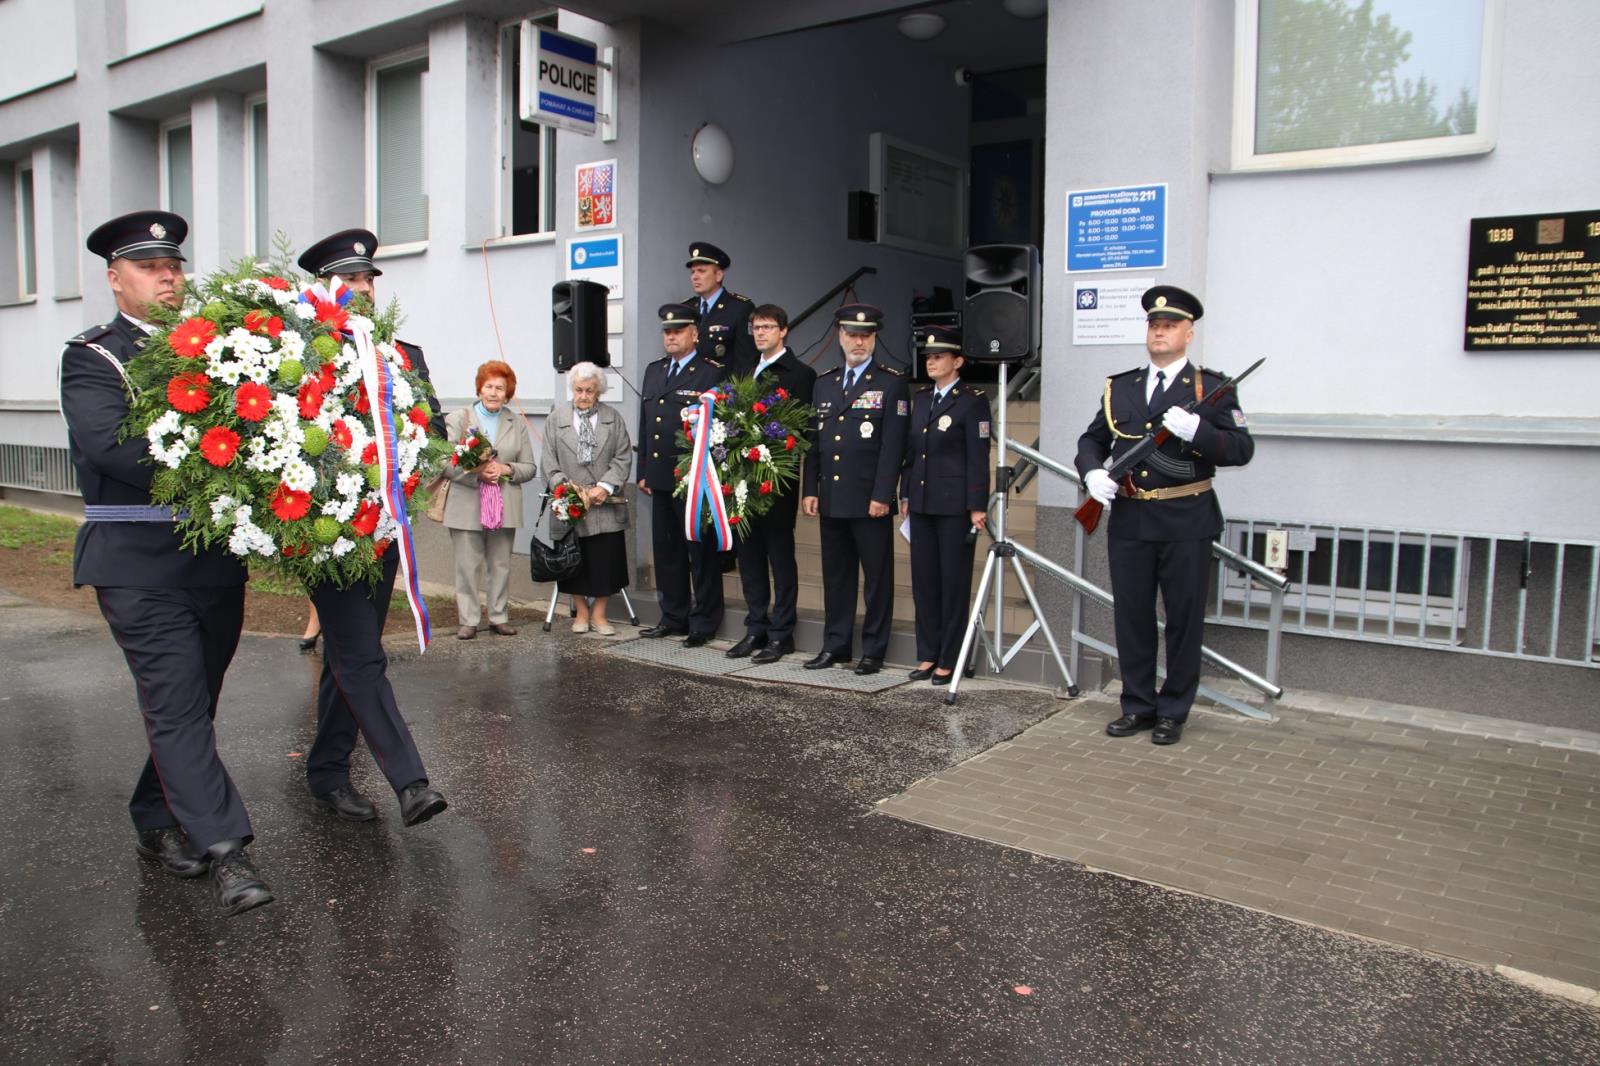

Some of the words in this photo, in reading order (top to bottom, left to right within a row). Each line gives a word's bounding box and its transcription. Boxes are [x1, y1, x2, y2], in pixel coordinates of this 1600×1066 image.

[539, 60, 596, 96] POLICIE
[1139, 190, 1156, 202] 211
[1090, 208, 1122, 217] PROVOZNÍ
[1488, 228, 1514, 243] 1939
[1588, 222, 1600, 237] 19
